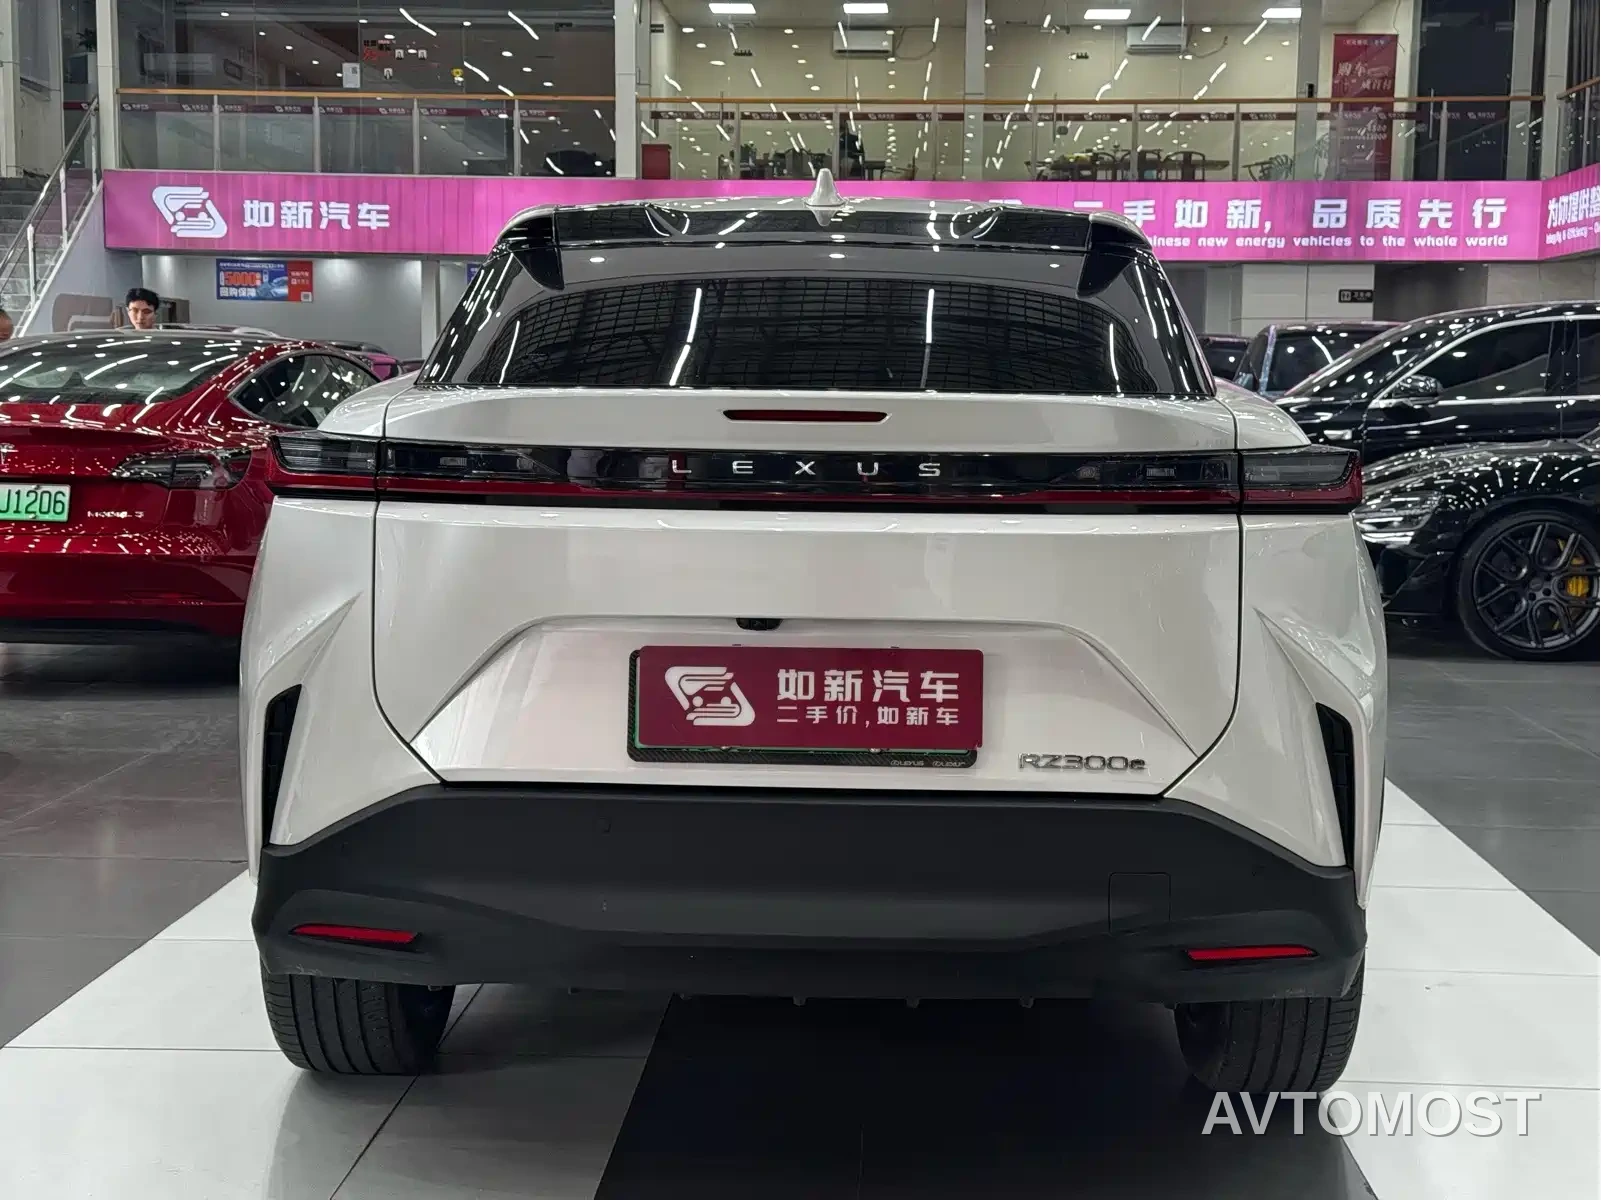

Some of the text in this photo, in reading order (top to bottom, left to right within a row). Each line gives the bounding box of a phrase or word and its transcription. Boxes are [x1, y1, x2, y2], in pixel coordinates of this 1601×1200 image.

[243, 200, 390, 230] 如新汽车
[1148, 235, 1508, 249] inese new energy vehicles to the whole world
[672, 459, 941, 477] LEXUS
[0, 489, 66, 515] J1206
[777, 668, 960, 702] 如新汽车
[1018, 753, 1147, 771] RZ300e
